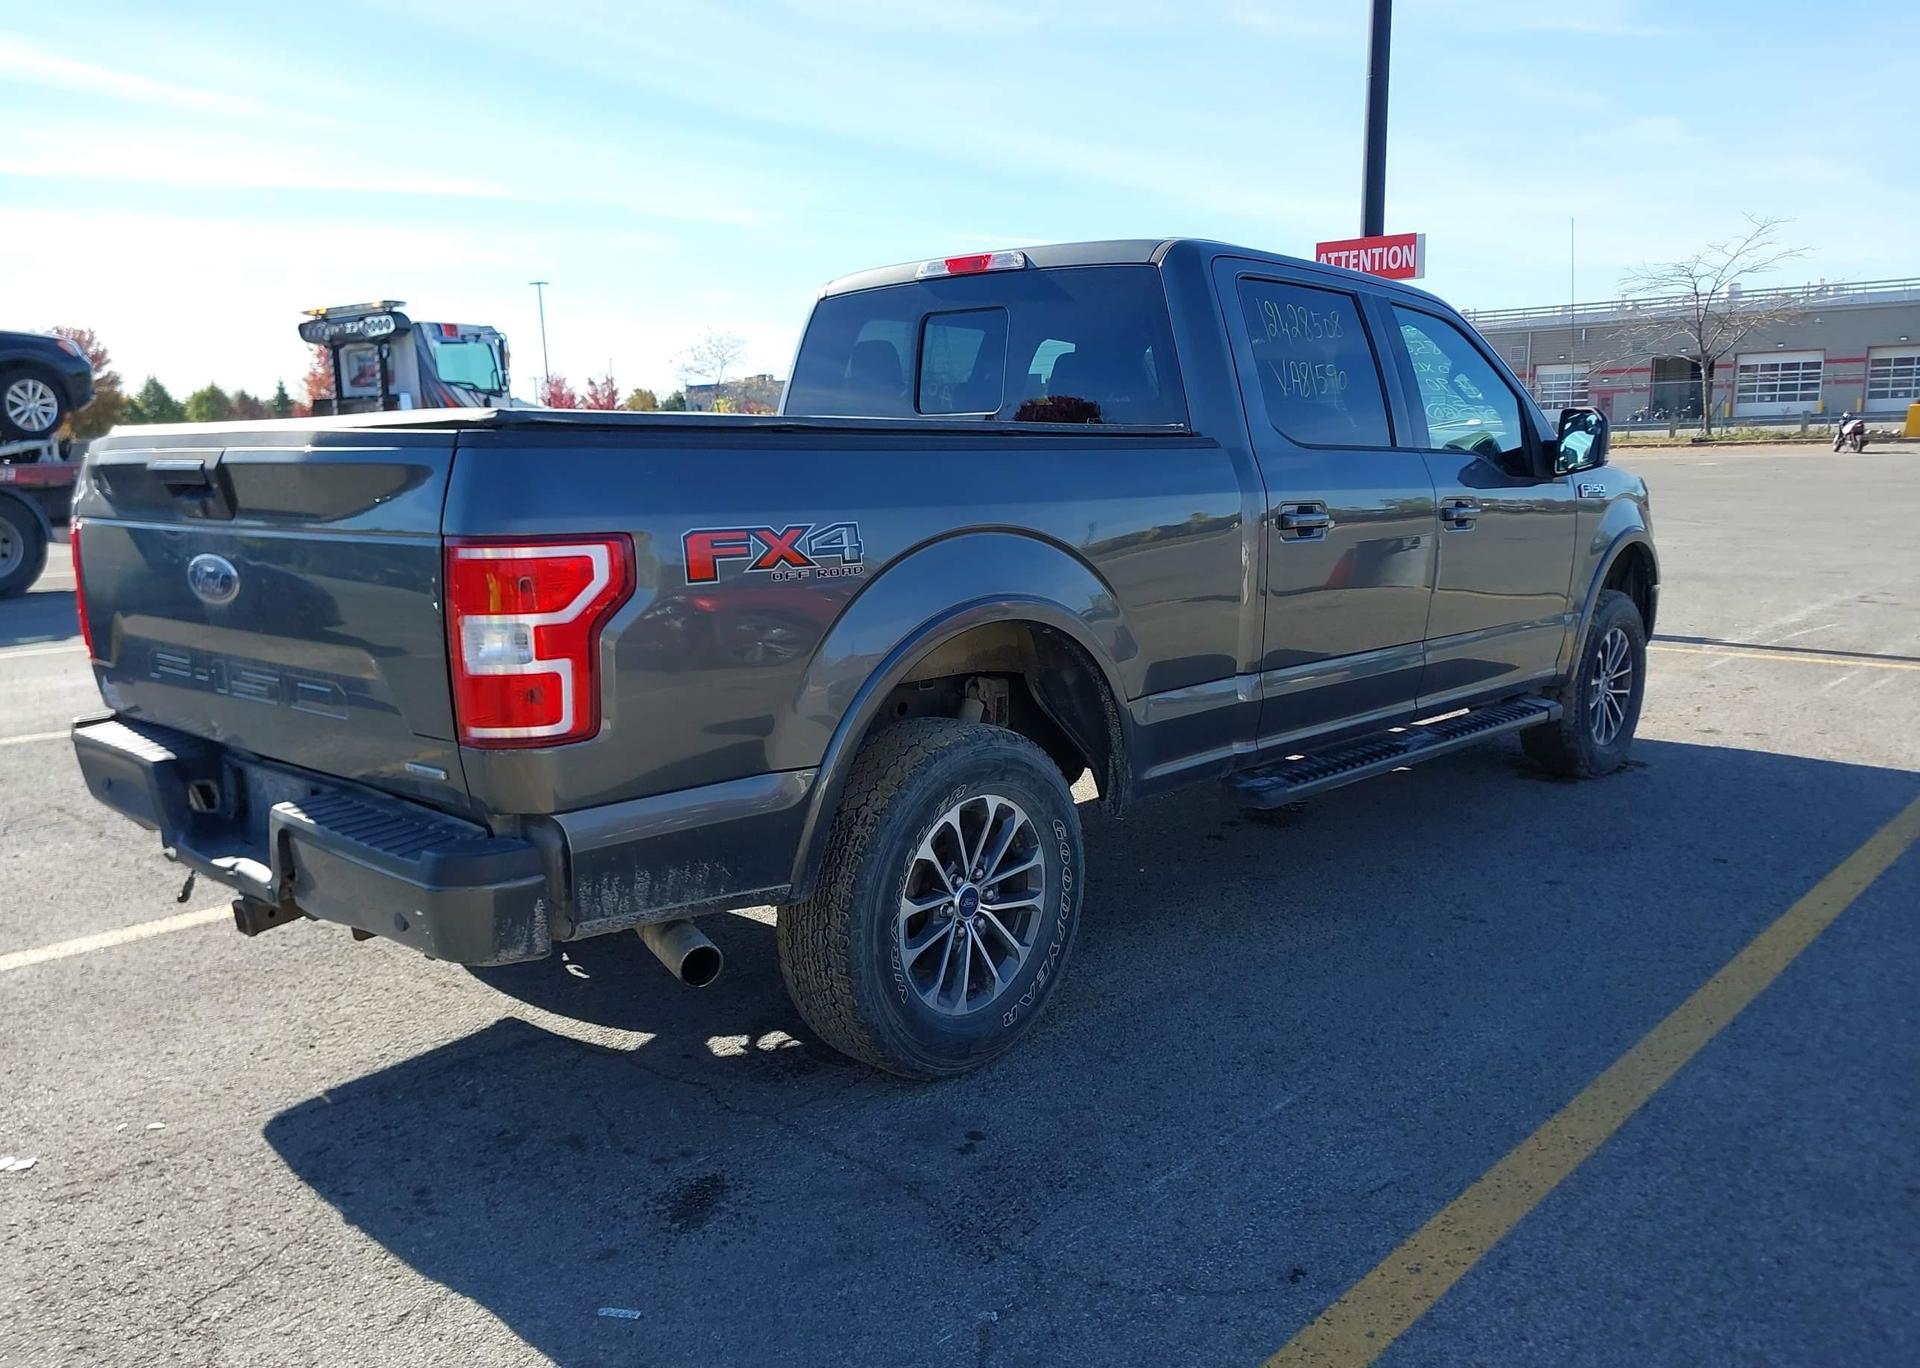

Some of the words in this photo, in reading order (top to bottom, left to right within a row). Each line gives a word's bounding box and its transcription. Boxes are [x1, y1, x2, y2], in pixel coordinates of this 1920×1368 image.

[681, 521, 864, 586] FX4
[771, 569, 810, 582] OFF
[816, 566, 865, 579] ROAD
